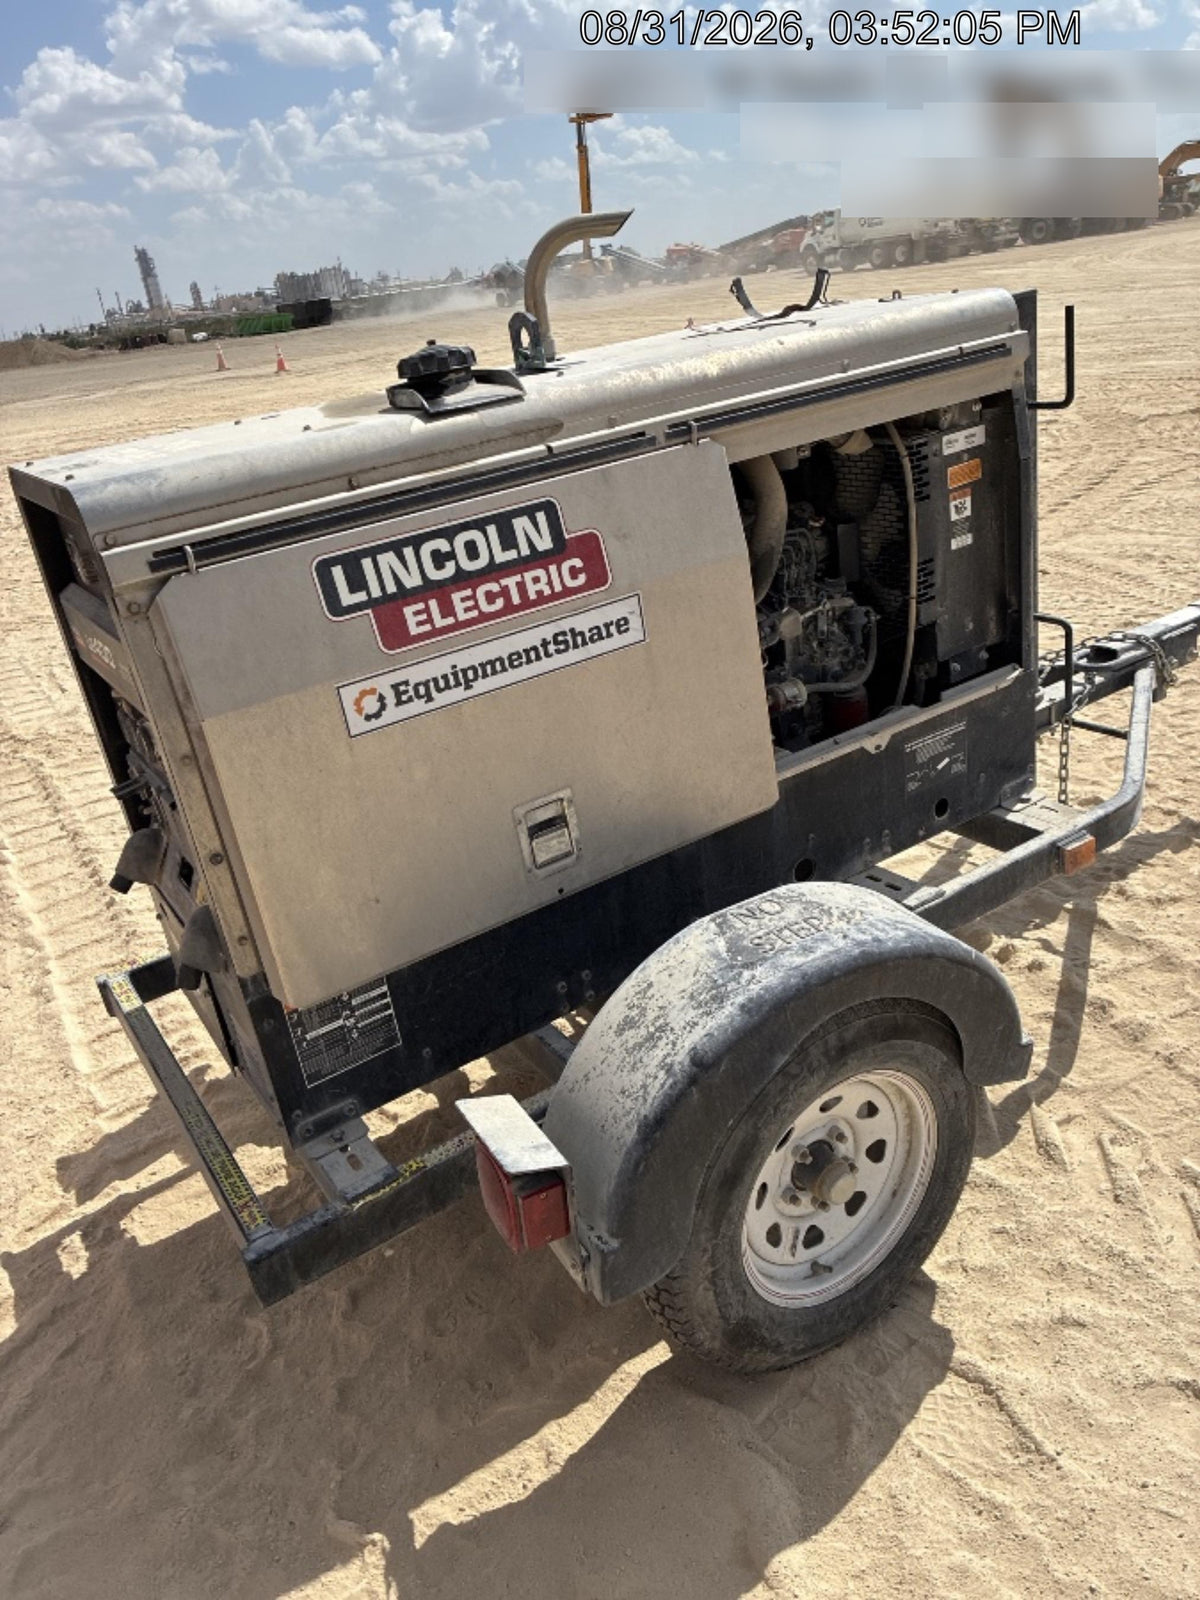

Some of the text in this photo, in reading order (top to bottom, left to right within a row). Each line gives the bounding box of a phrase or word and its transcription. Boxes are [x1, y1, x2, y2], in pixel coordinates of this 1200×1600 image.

[331, 510, 554, 608] LINCOLN
[403, 557, 587, 636] ELECTRIC
[391, 615, 631, 708] EquipmentShare
[729, 898, 784, 926] NO
[749, 916, 825, 954] STEP
